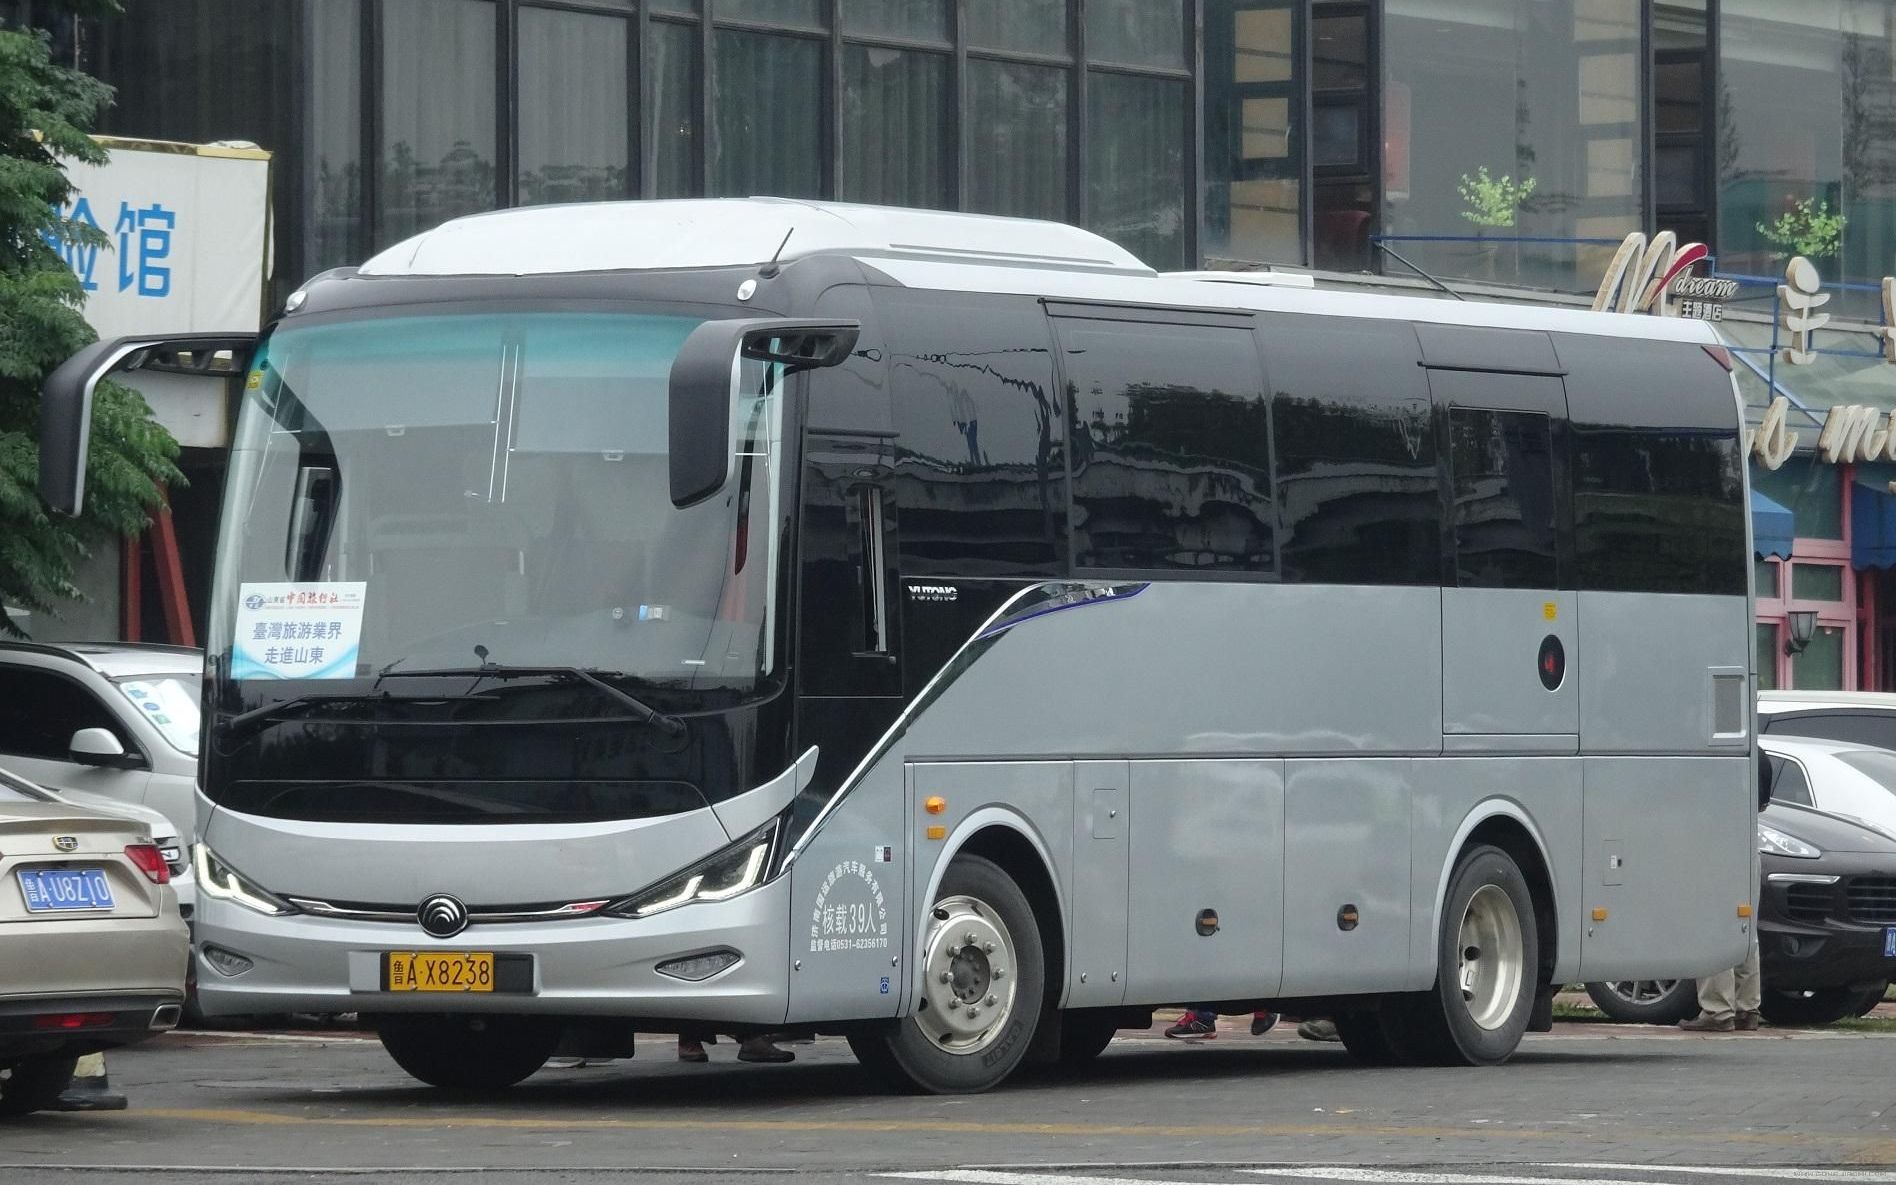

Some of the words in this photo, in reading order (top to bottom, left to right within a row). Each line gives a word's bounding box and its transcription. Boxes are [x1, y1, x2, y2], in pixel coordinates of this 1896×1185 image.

[1681, 300, 1723, 321] 主题酒店
[264, 646, 325, 665] 走進山東
